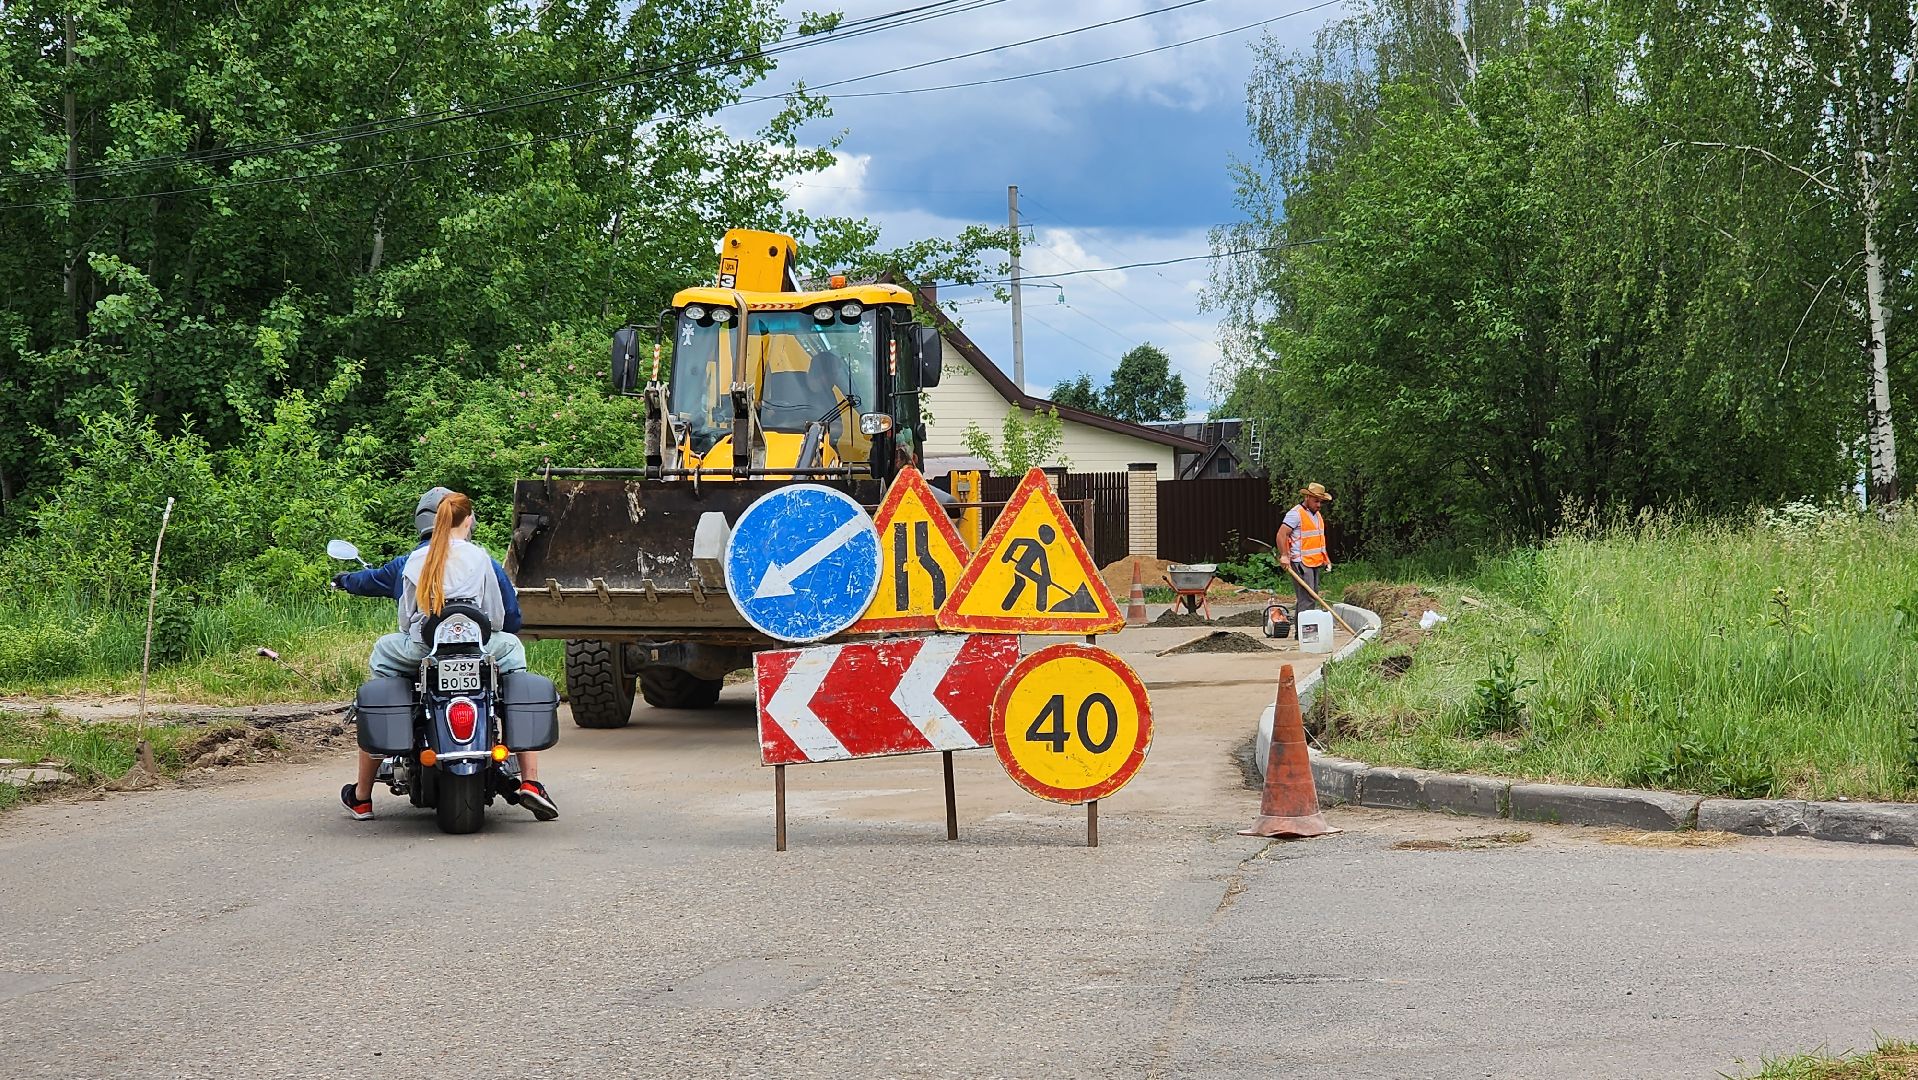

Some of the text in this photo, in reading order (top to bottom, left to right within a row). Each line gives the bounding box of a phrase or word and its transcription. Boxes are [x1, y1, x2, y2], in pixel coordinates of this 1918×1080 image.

[720, 275, 734, 287] 3
[463, 677, 478, 688] 50
[1026, 692, 1118, 754] 40
